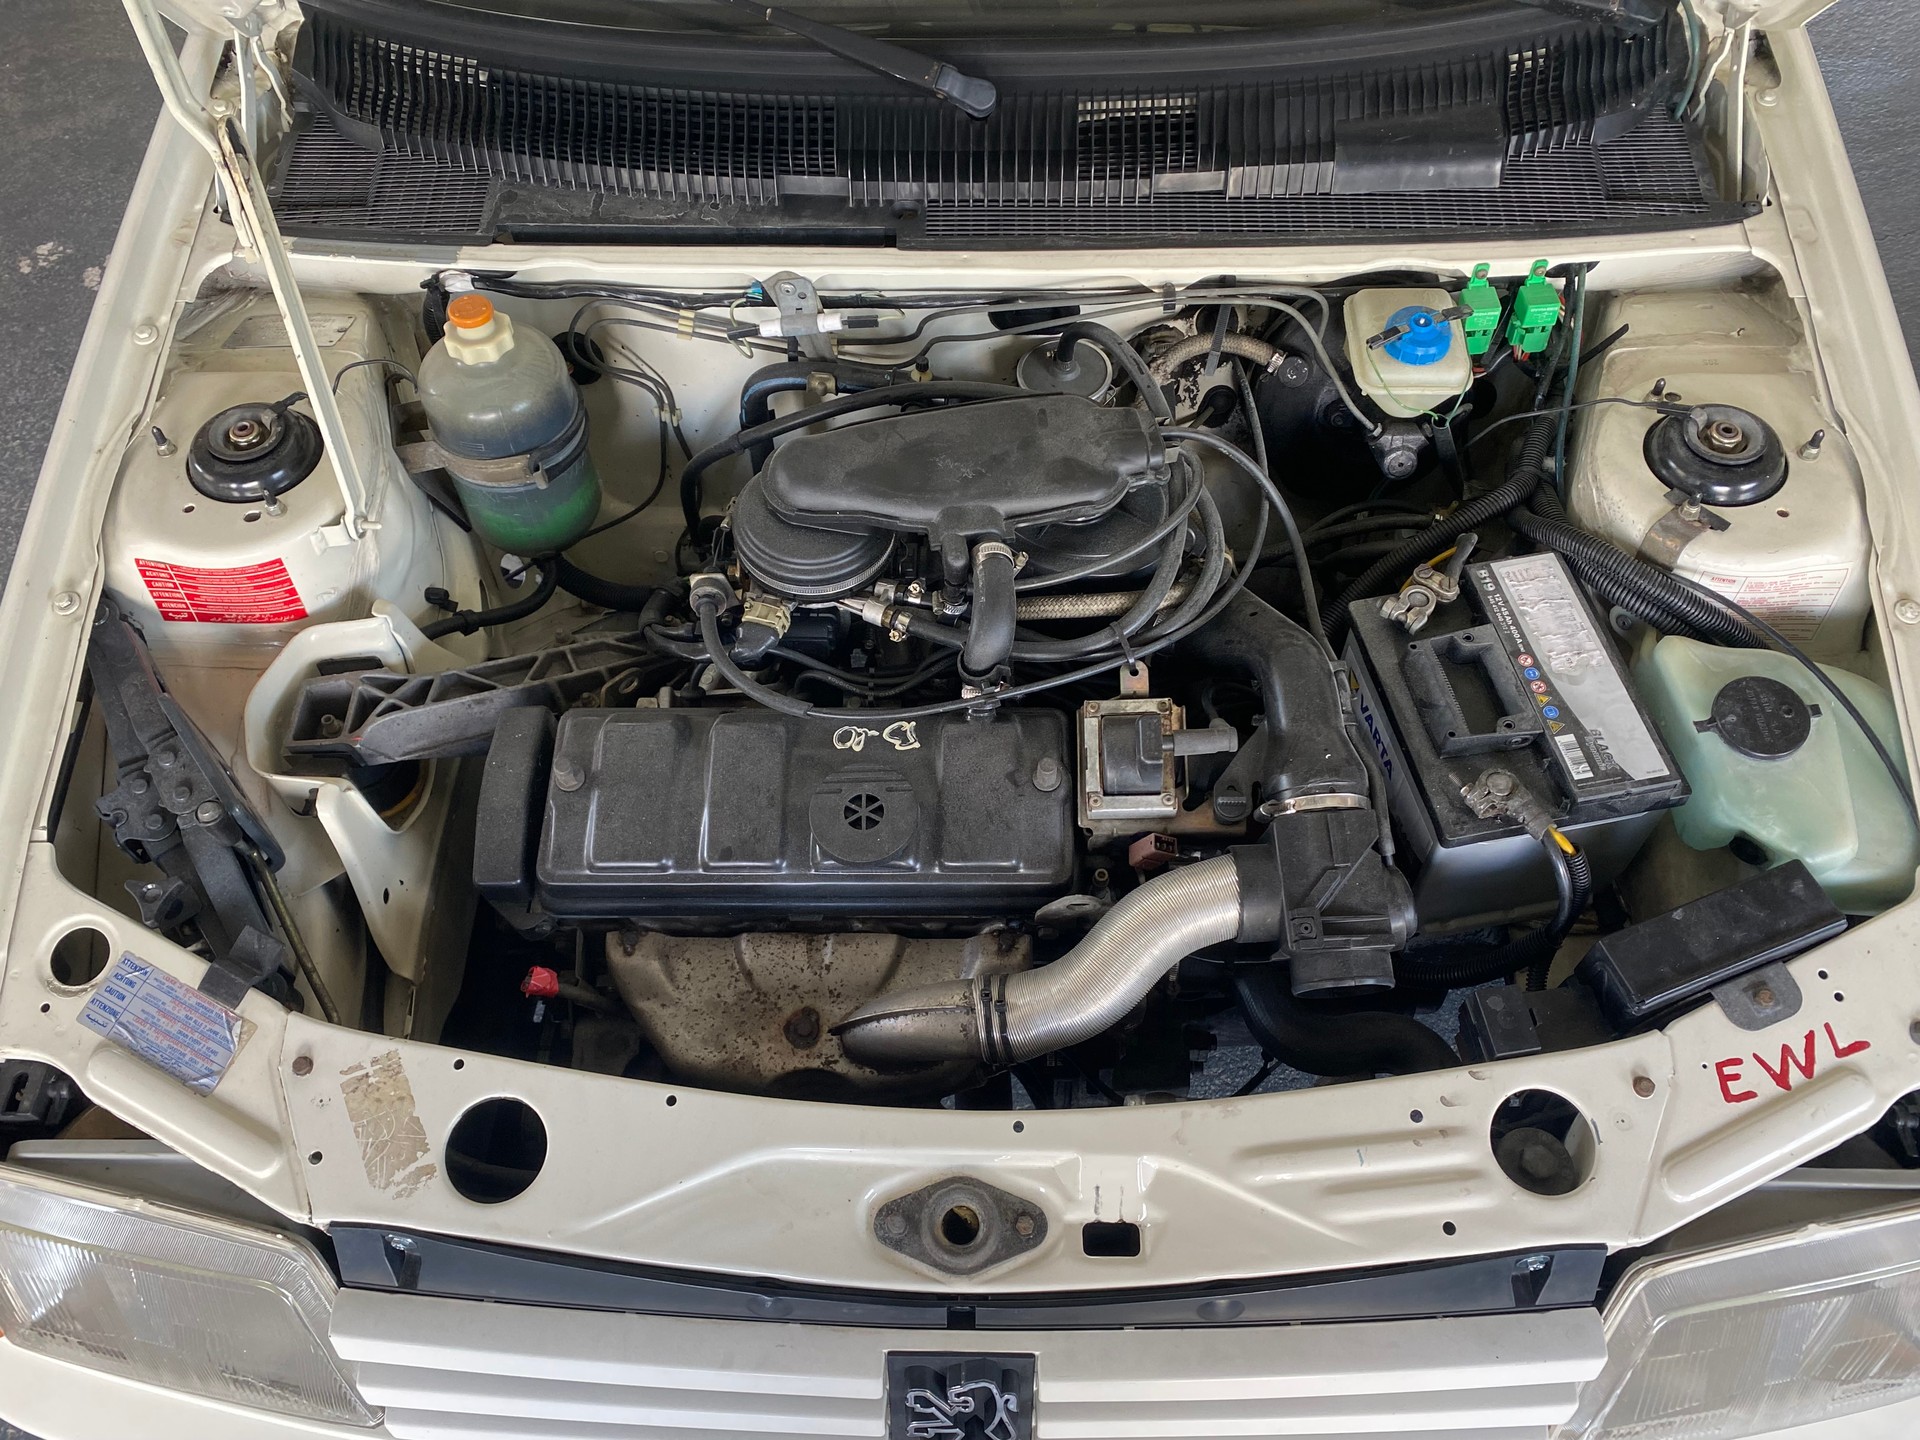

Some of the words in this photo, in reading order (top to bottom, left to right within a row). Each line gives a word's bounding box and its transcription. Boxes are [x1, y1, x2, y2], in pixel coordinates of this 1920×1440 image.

[139, 560, 166, 568] ATTENTION
[1476, 569, 1496, 592] B19
[1711, 576, 1736, 584] ATTENTION
[1494, 593, 1504, 606] 12V
[1500, 607, 1513, 625] 45Ah
[1358, 694, 1395, 782] VARTA
[1589, 728, 1620, 770] BLACK
[121, 957, 150, 977] ATTENTION
[114, 973, 137, 988] ACHTUNG
[104, 985, 126, 1001] CAUTION
[90, 998, 120, 1018] ATTENZIONE
[188, 1036, 201, 1046] EVERY
[205, 1046, 218, 1056] YEARS
[1715, 1022, 1871, 1103] EWL
